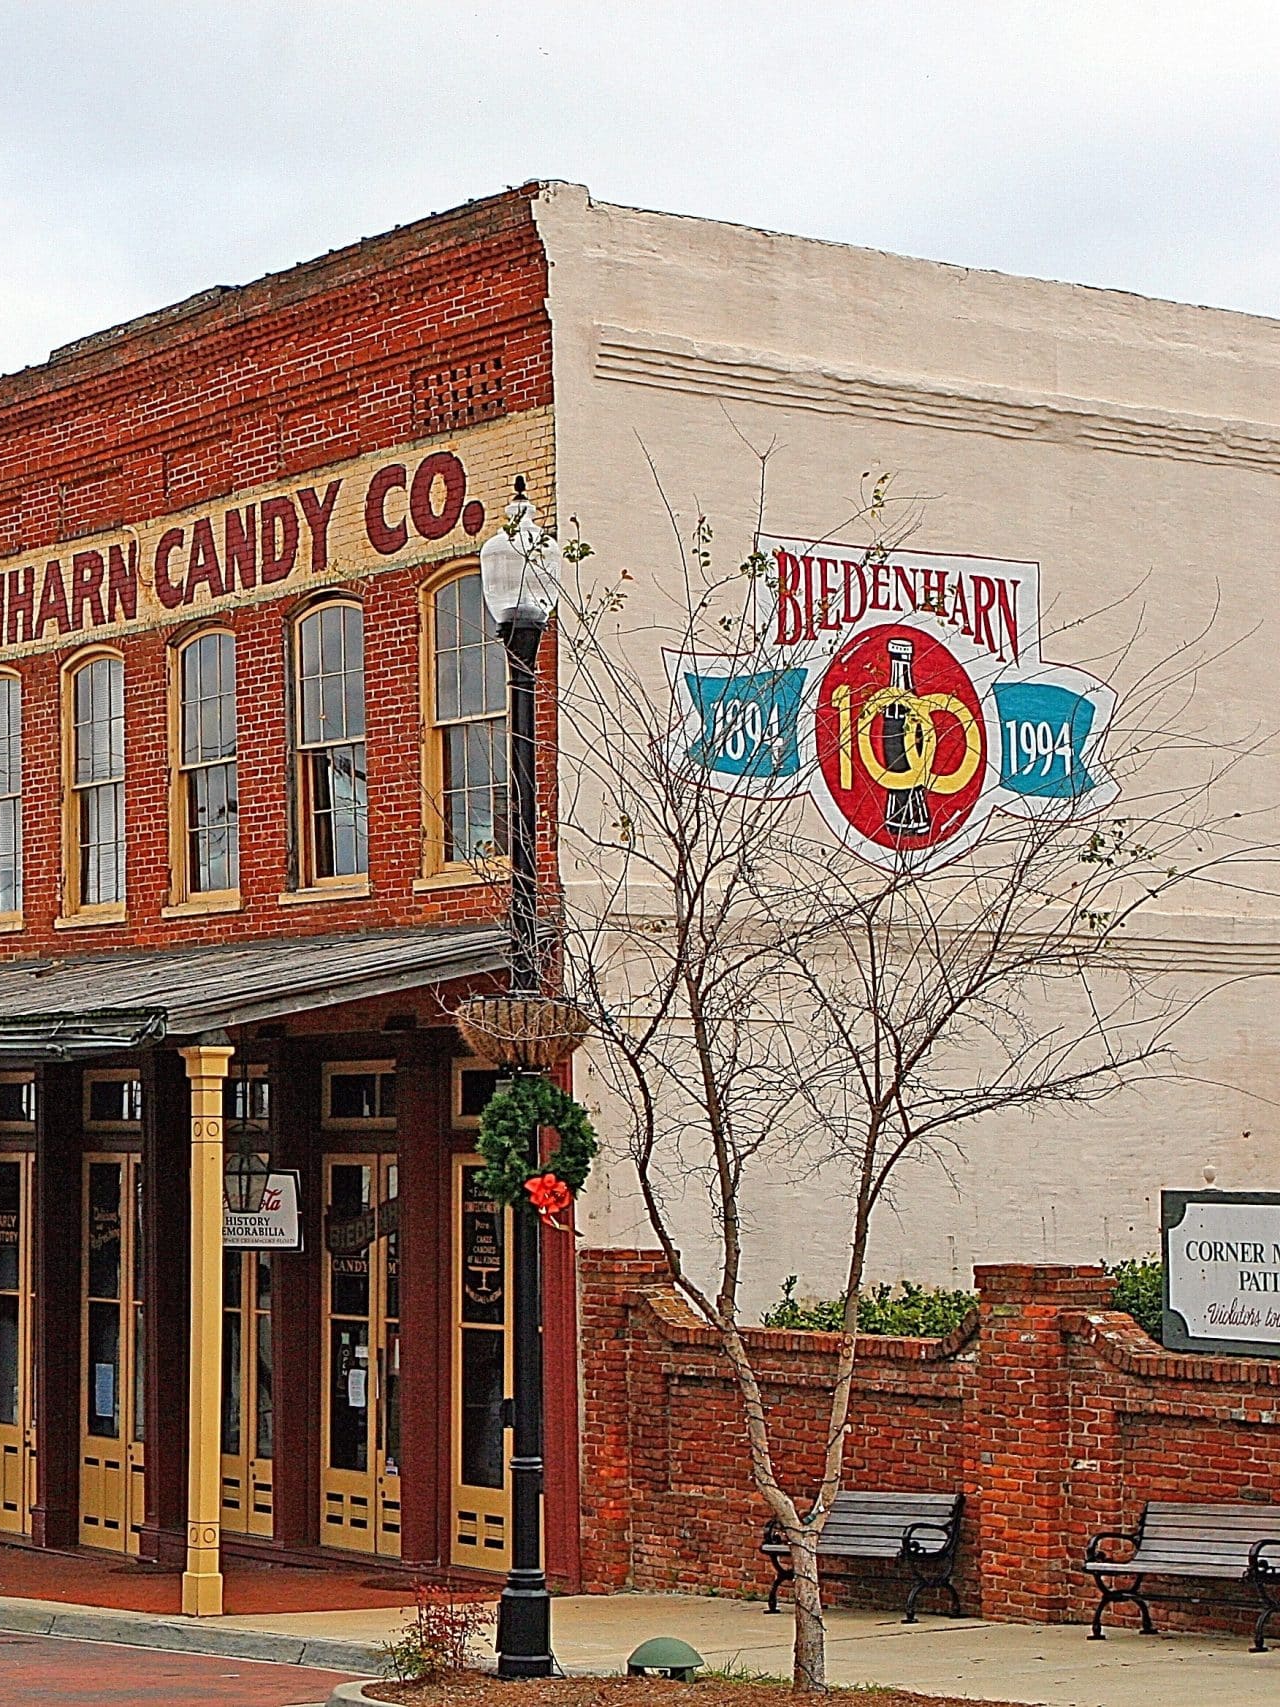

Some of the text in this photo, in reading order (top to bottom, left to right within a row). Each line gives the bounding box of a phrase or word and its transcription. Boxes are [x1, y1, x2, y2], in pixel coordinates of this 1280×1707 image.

[154, 479, 342, 610] CANDY
[365, 449, 485, 556] CO.
[773, 550, 1022, 669] BIEDENHARN
[710, 698, 786, 760] 1894
[830, 683, 982, 794] 100
[1006, 719, 1073, 777] 1994
[222, 1226, 285, 1237] EMORABILIA
[225, 1216, 271, 1226] HISTORY
[332, 1259, 368, 1273] CANDY
[1185, 1240, 1266, 1264] CORNER
[1206, 1296, 1262, 1328] Violators
